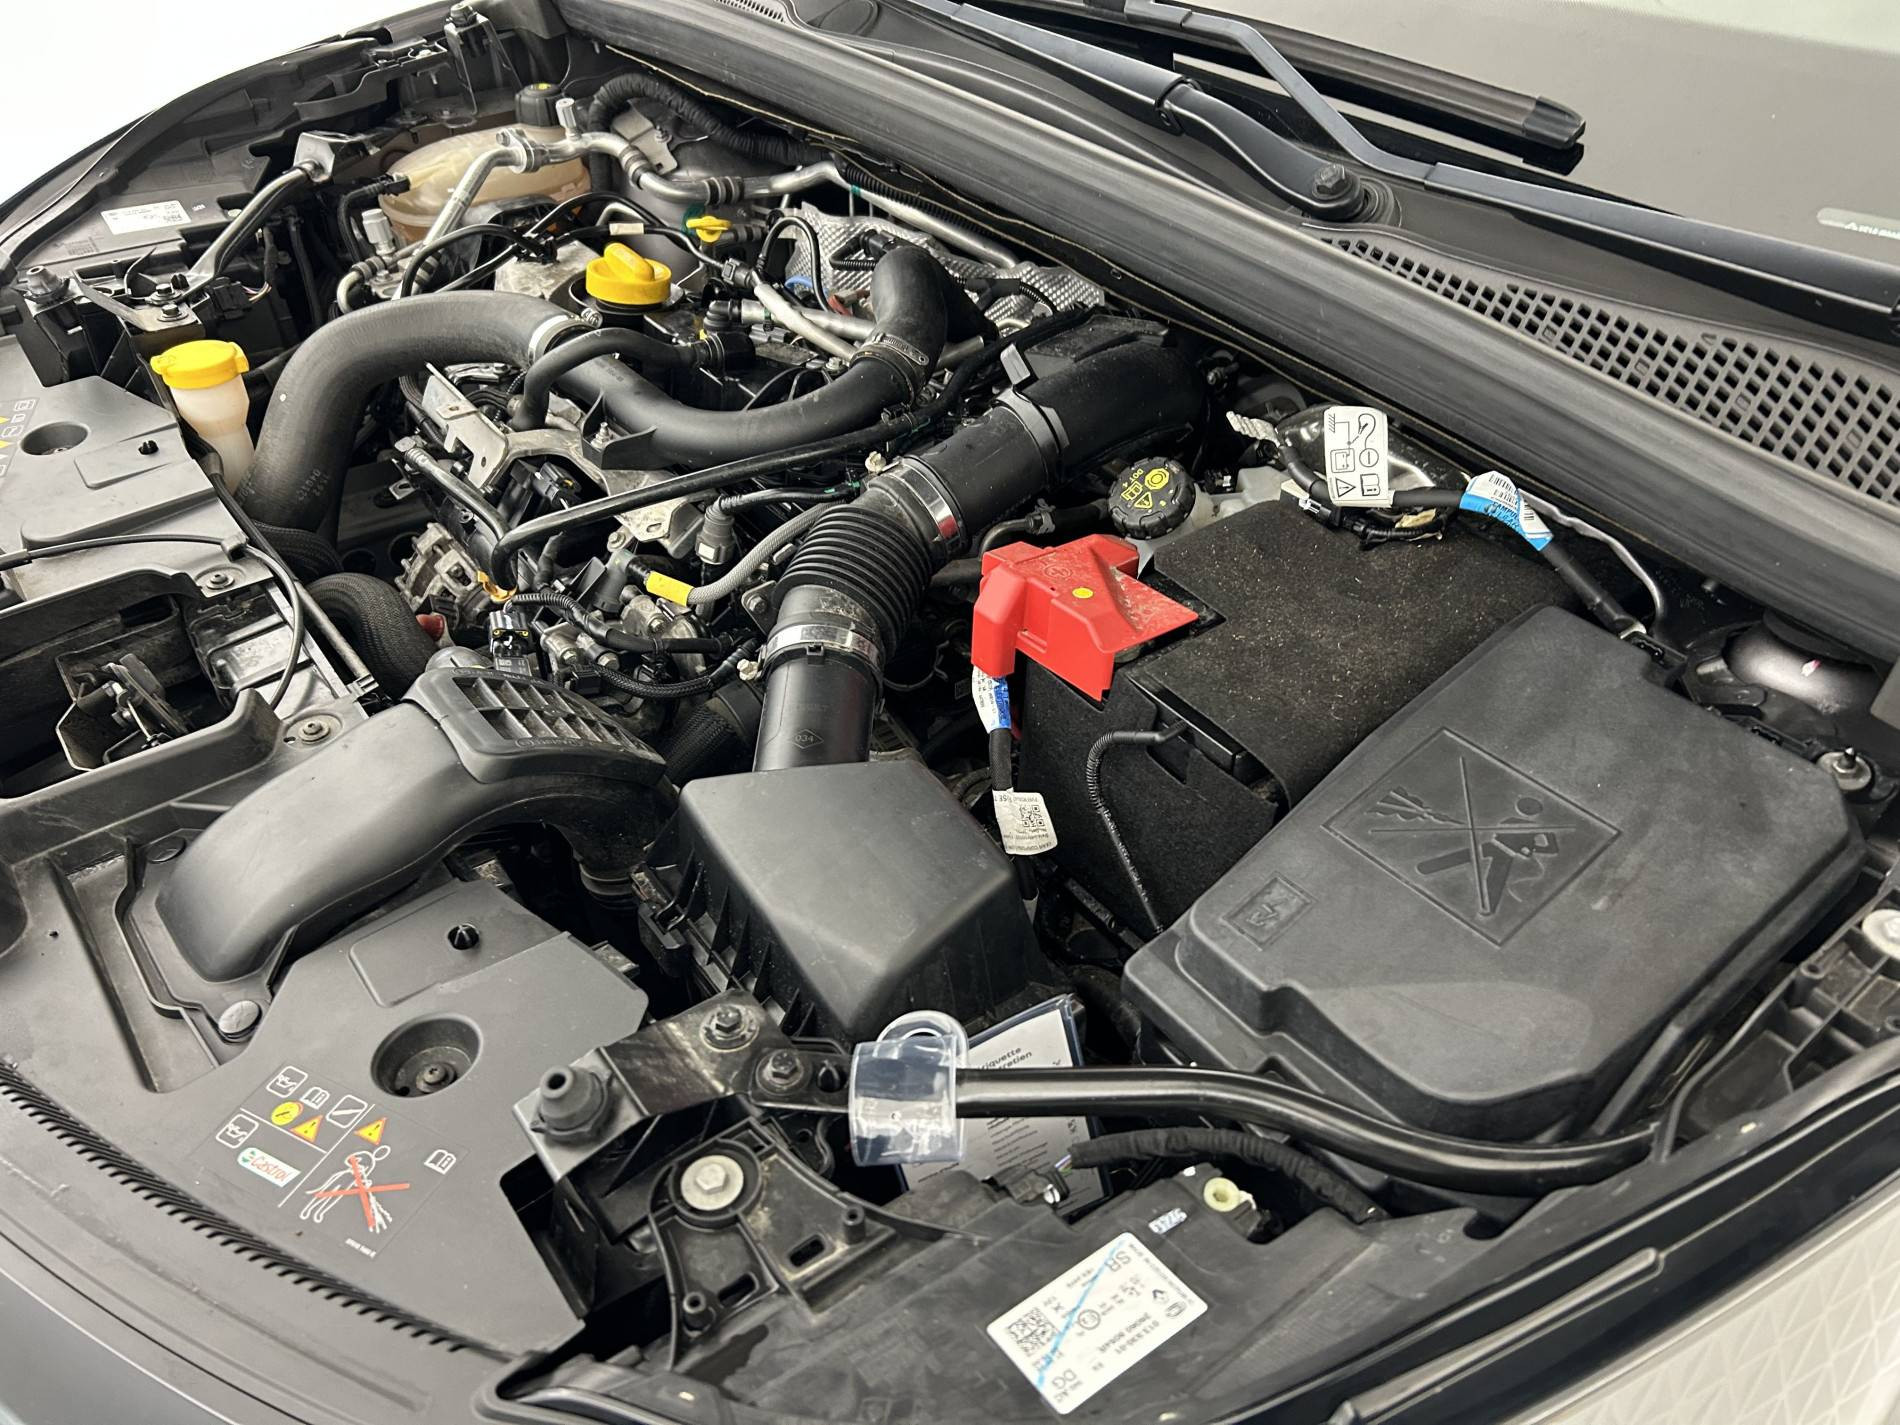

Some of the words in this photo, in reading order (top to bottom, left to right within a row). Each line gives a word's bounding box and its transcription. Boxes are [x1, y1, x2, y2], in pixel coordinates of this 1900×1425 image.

[1128, 467, 1144, 484] DOT
[250, 1155, 291, 1182] Castrol
[1050, 1368, 1076, 1390] DG
